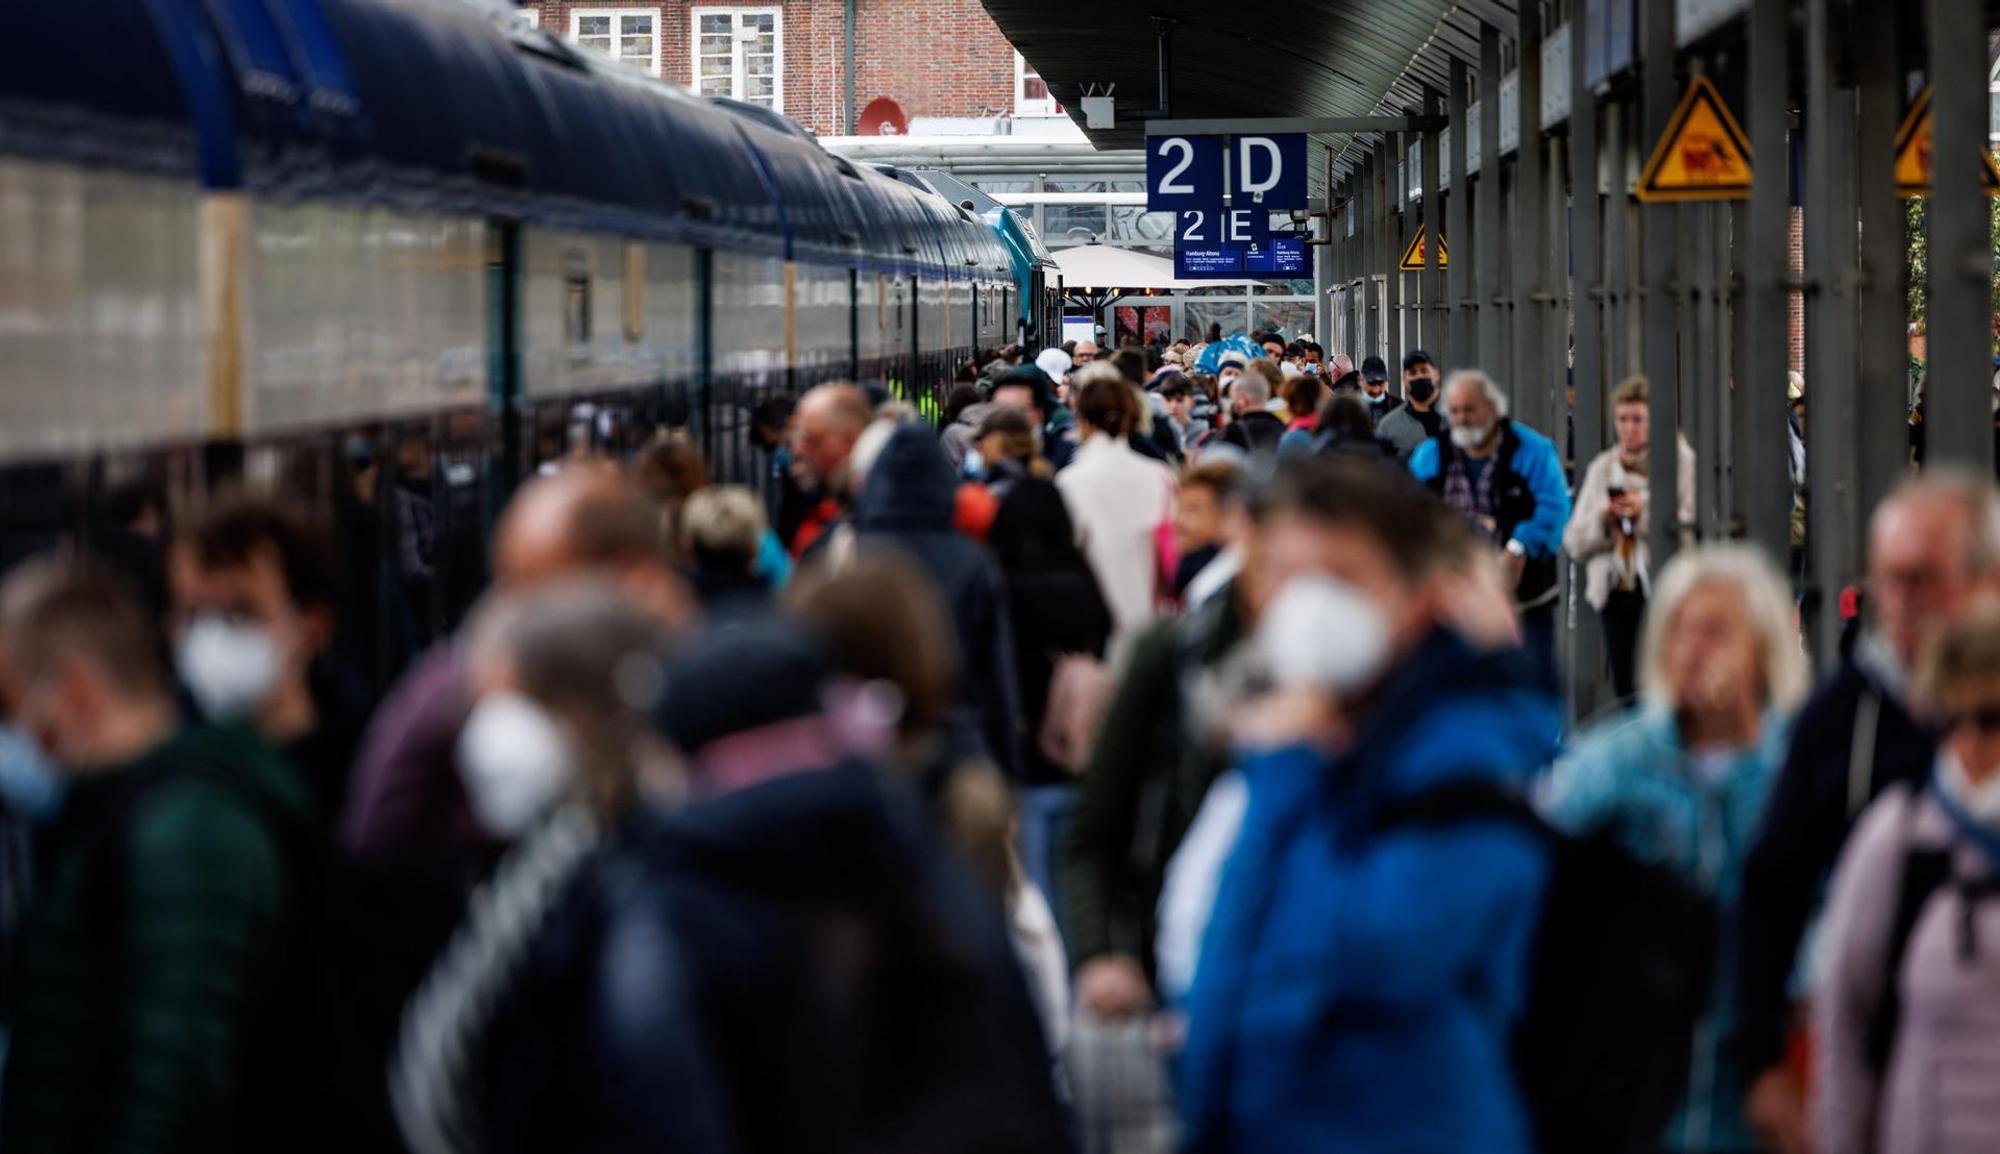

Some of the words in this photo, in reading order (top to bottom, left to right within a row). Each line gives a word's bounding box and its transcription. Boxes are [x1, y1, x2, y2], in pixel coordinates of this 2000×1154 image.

[1158, 137, 1194, 194] 2
[1240, 137, 1282, 193] D
[1183, 210, 1204, 241] 2
[1231, 210, 1252, 241] E
